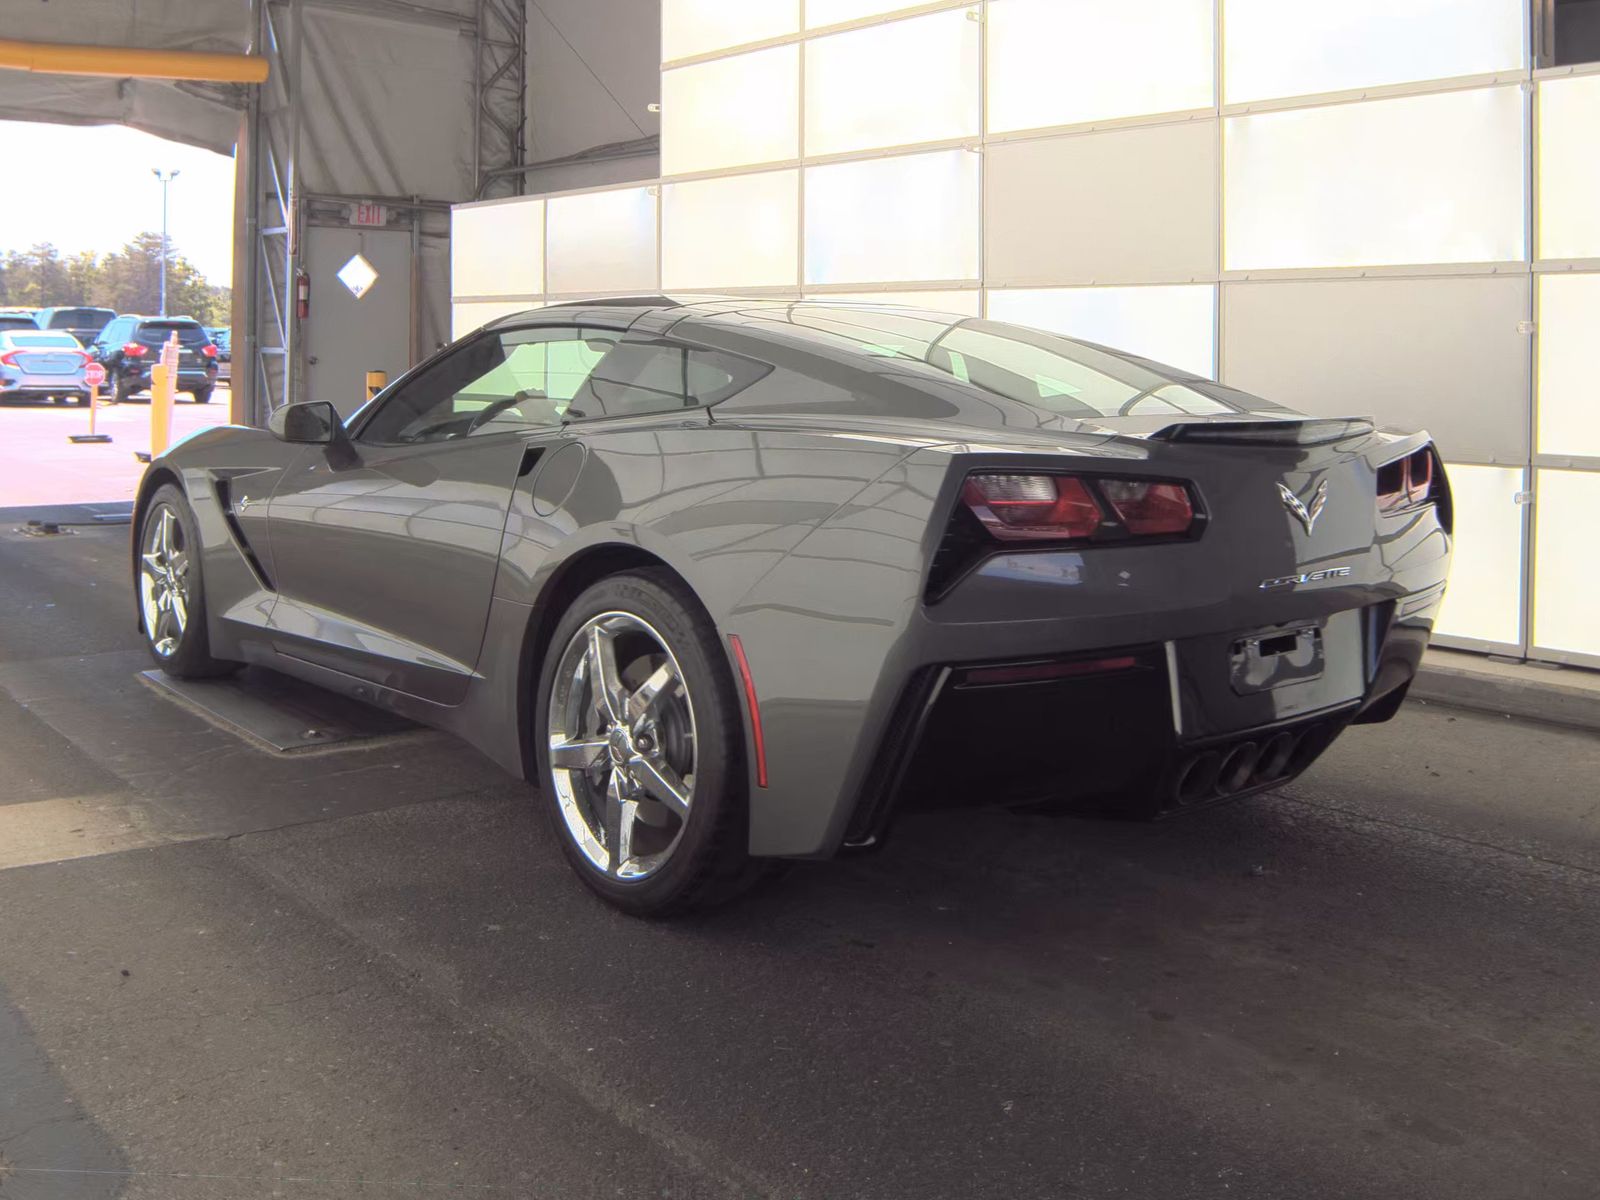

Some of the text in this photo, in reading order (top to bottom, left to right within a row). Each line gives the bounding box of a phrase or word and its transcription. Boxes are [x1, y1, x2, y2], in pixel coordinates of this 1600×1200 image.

[357, 205, 383, 225] EXIT
[85, 369, 104, 379] STOP
[1258, 566, 1352, 588] CORVETTE
